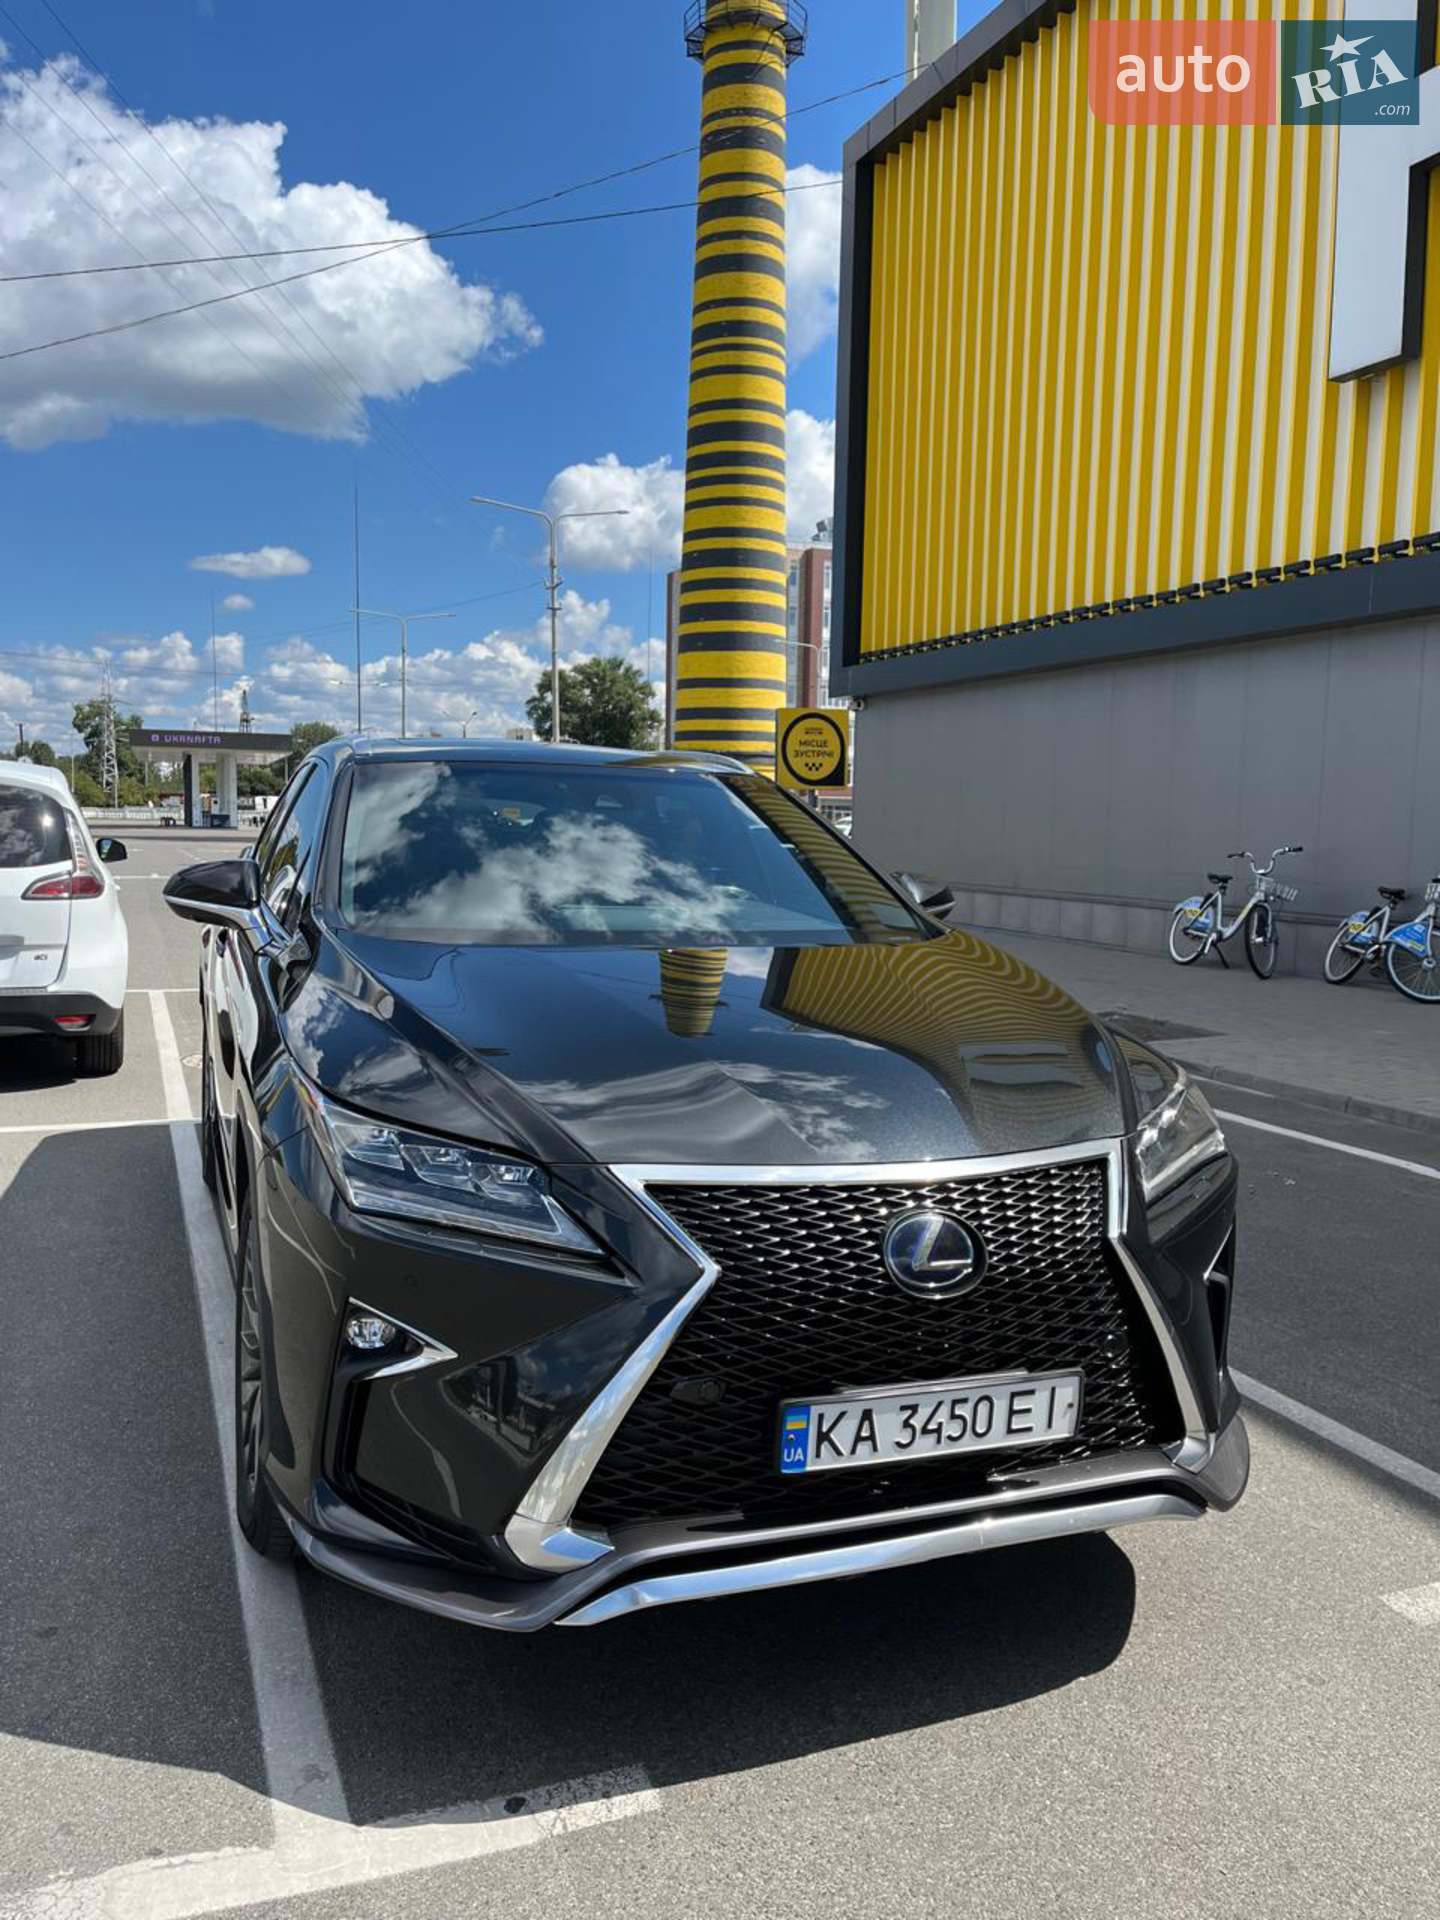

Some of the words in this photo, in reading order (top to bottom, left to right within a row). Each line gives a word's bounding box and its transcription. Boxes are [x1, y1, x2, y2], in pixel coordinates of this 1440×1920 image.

[814, 1407, 880, 1459] KA
[894, 1394, 995, 1450] 3450
[1005, 1386, 1058, 1435] EI
[783, 1447, 804, 1463] UA
